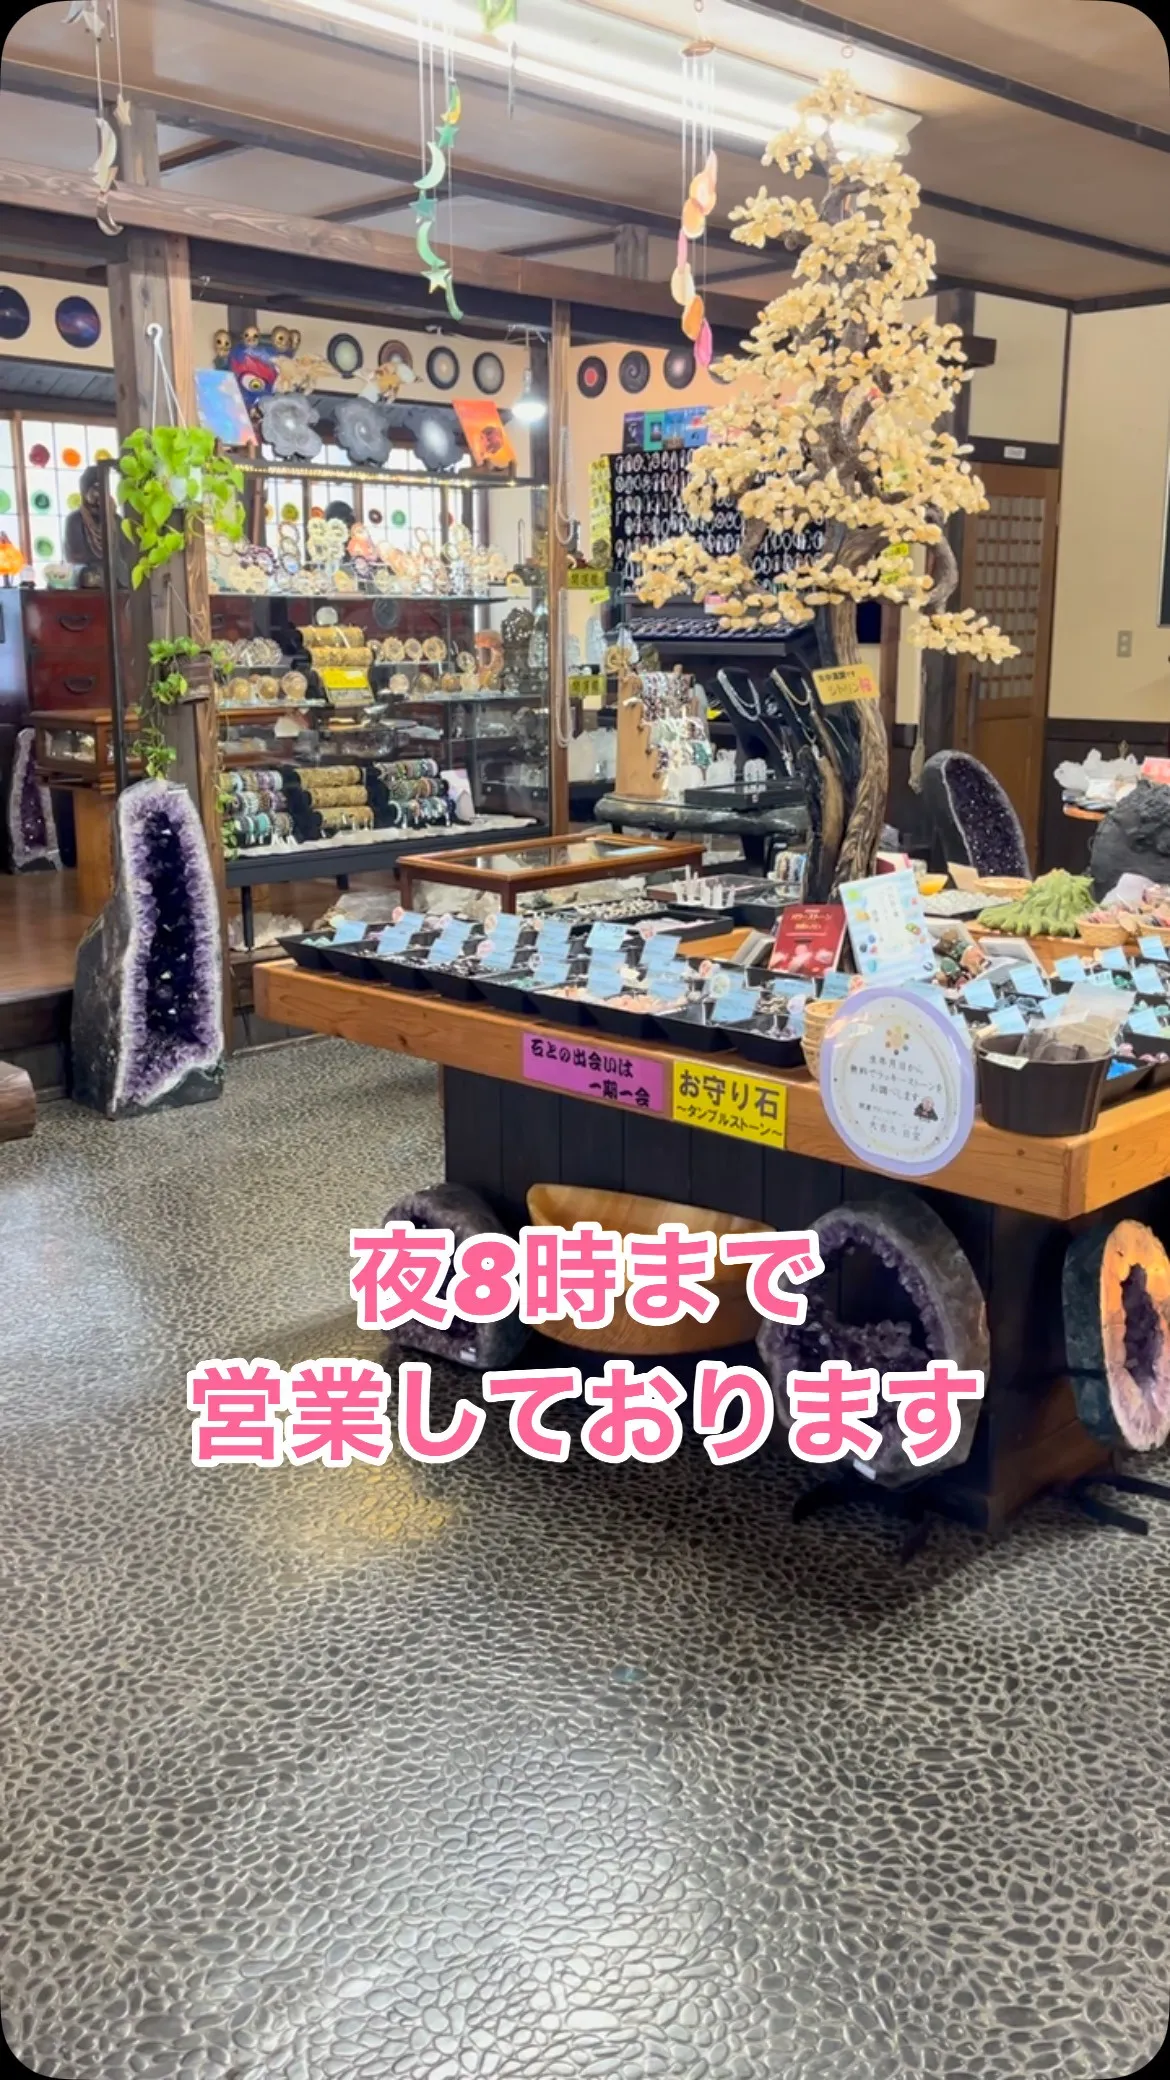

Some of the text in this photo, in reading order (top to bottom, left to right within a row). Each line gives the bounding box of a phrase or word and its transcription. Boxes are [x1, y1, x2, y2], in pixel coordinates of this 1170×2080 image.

[530, 1039, 634, 1078] 石との出会いは
[588, 1079, 651, 1108] 一期一会
[679, 1069, 780, 1120] お守り石
